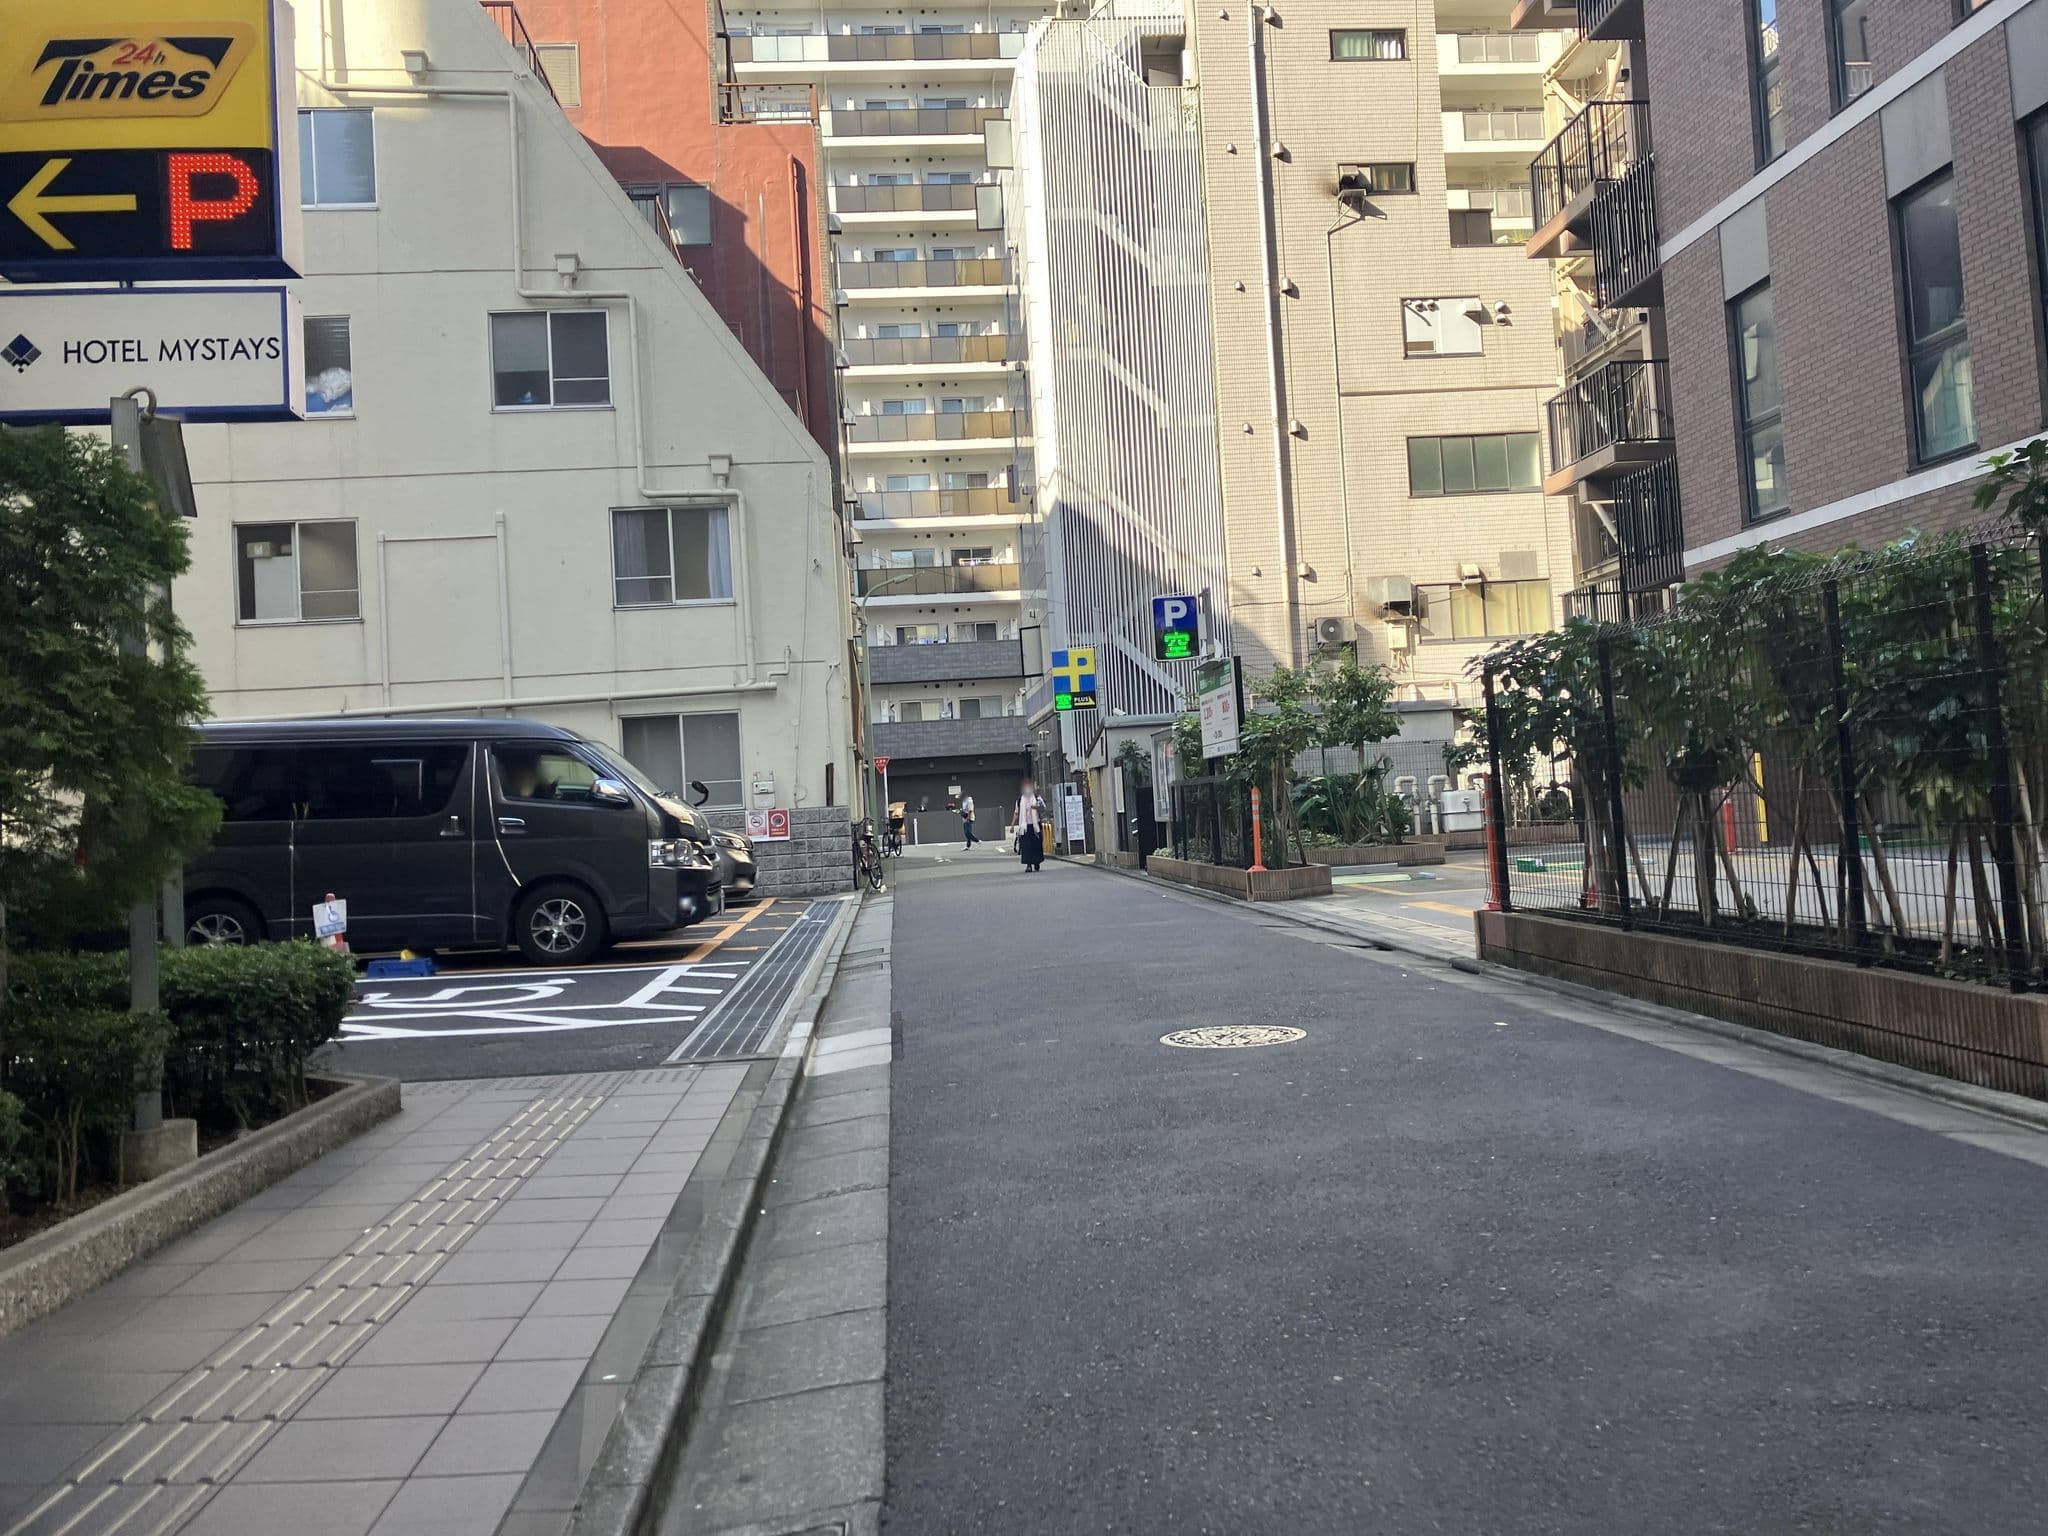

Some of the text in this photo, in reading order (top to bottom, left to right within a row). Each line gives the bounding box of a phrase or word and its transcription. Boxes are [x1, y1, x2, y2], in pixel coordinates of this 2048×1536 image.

[112, 43, 166, 65] 24h
[39, 57, 211, 105] Times
[169, 153, 259, 249] P
[63, 337, 280, 364] HOTEL MYSTAYS
[1163, 600, 1188, 627] P
